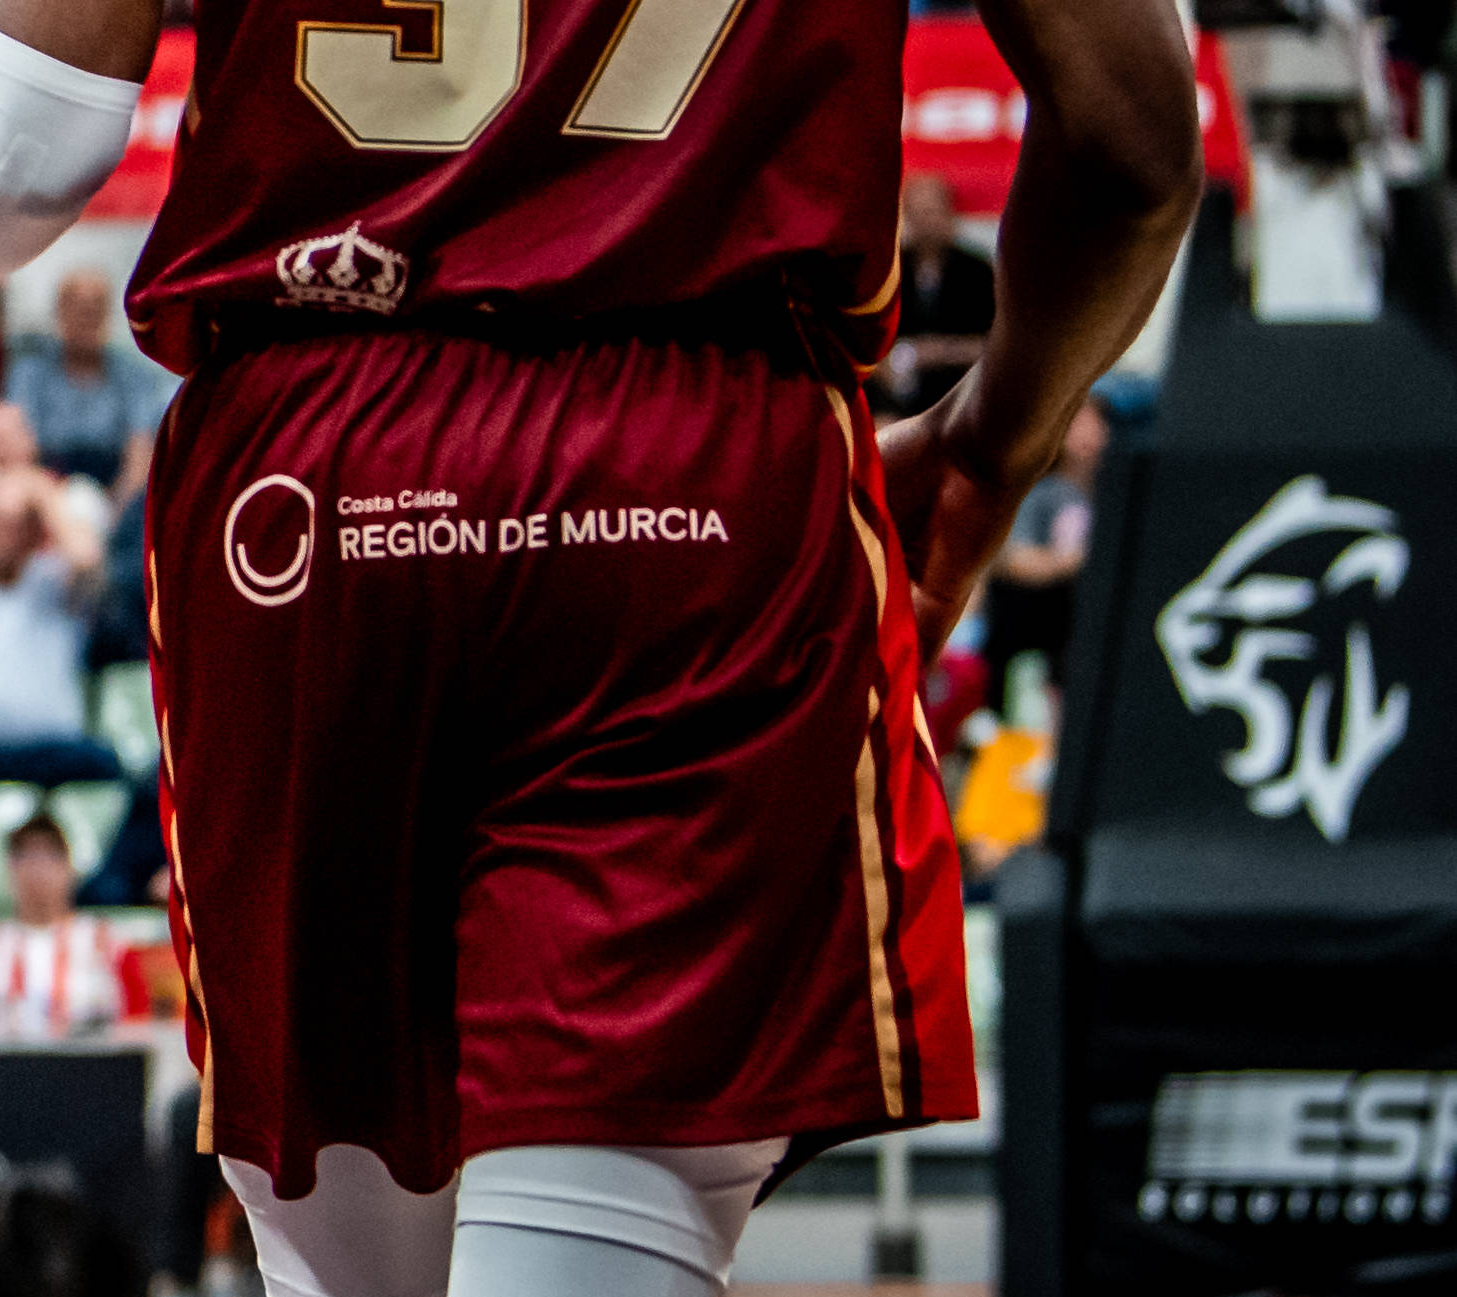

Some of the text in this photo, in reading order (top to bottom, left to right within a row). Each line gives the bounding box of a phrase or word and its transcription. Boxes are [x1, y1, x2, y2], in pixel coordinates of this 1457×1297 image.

[337, 489, 458, 515] Costa Cálida
[339, 507, 729, 561] REGIÓN DE MURCIA
[1195, 1070, 1457, 1182] ES
